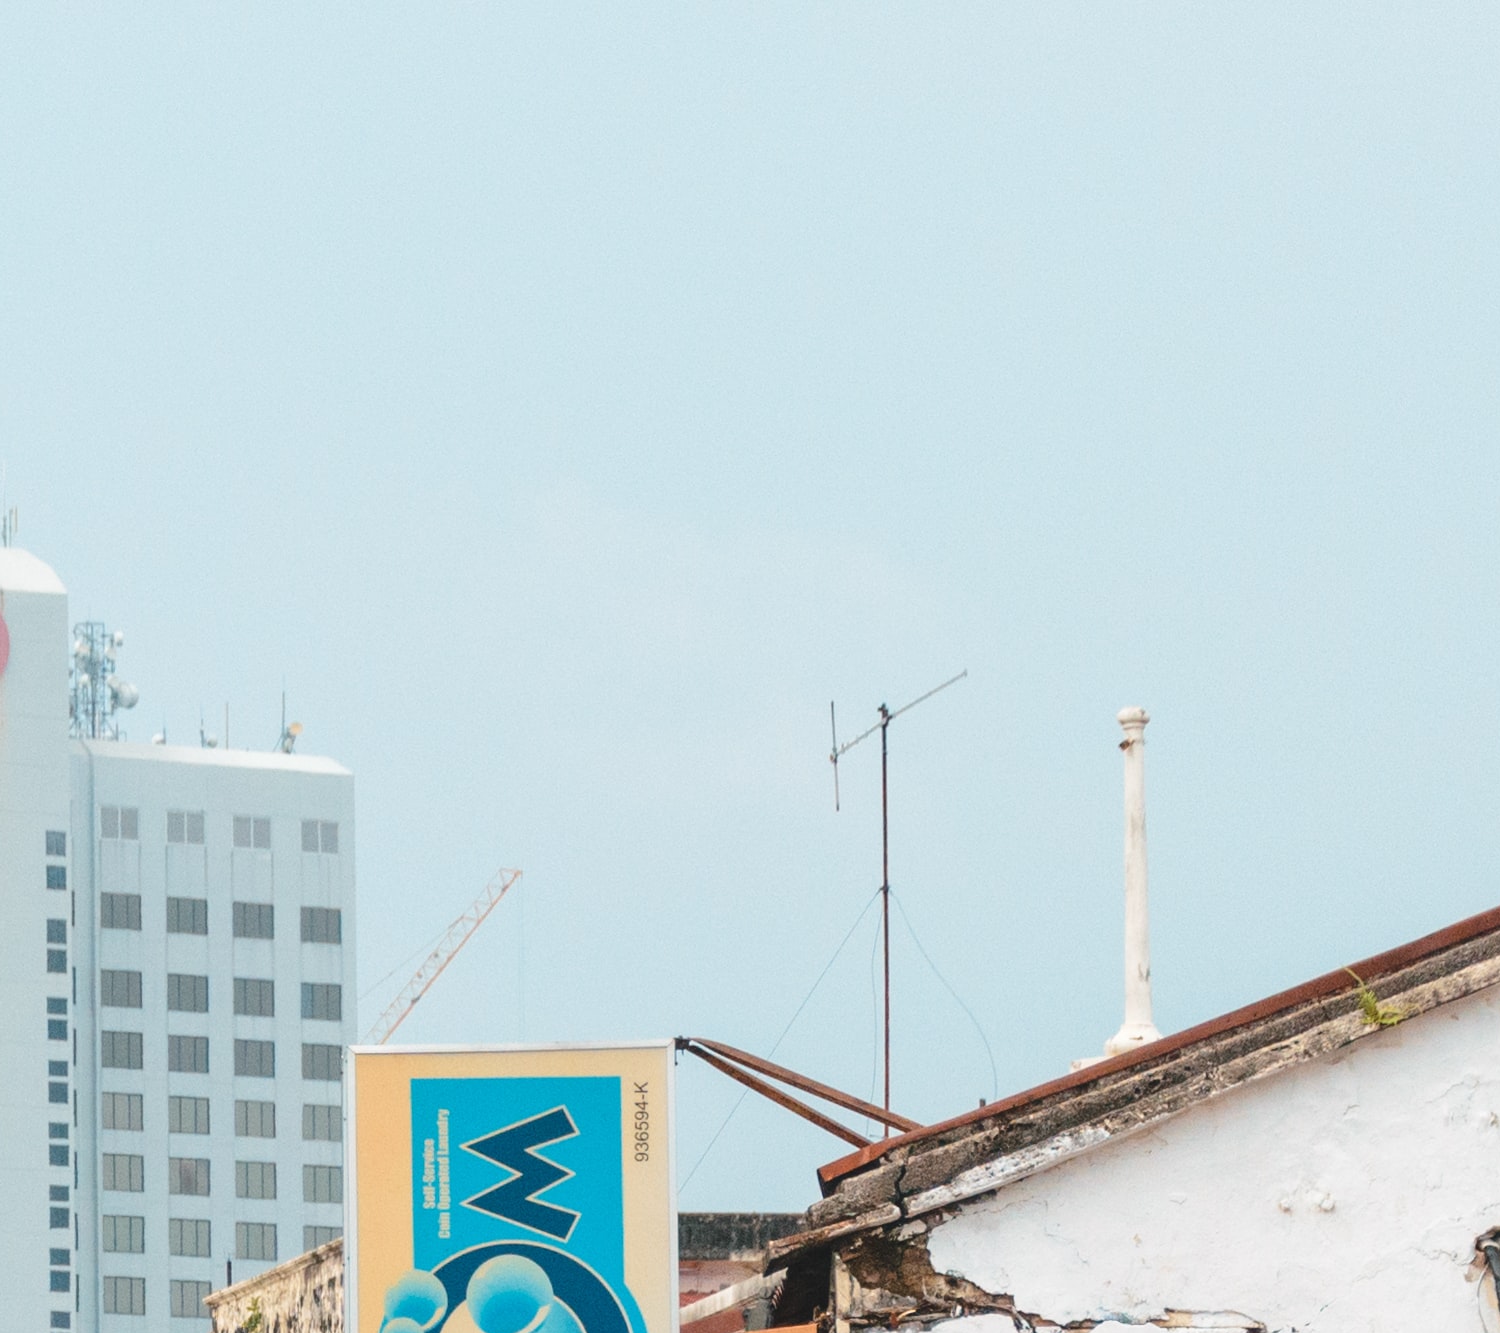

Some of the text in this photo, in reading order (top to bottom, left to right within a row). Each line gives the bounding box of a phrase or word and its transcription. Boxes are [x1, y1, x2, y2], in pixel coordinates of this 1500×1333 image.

[633, 1081, 650, 1163] 936594-K
[422, 1137, 436, 1210] Self-Service
[436, 1108, 451, 1239] Coin Operated Laundry
